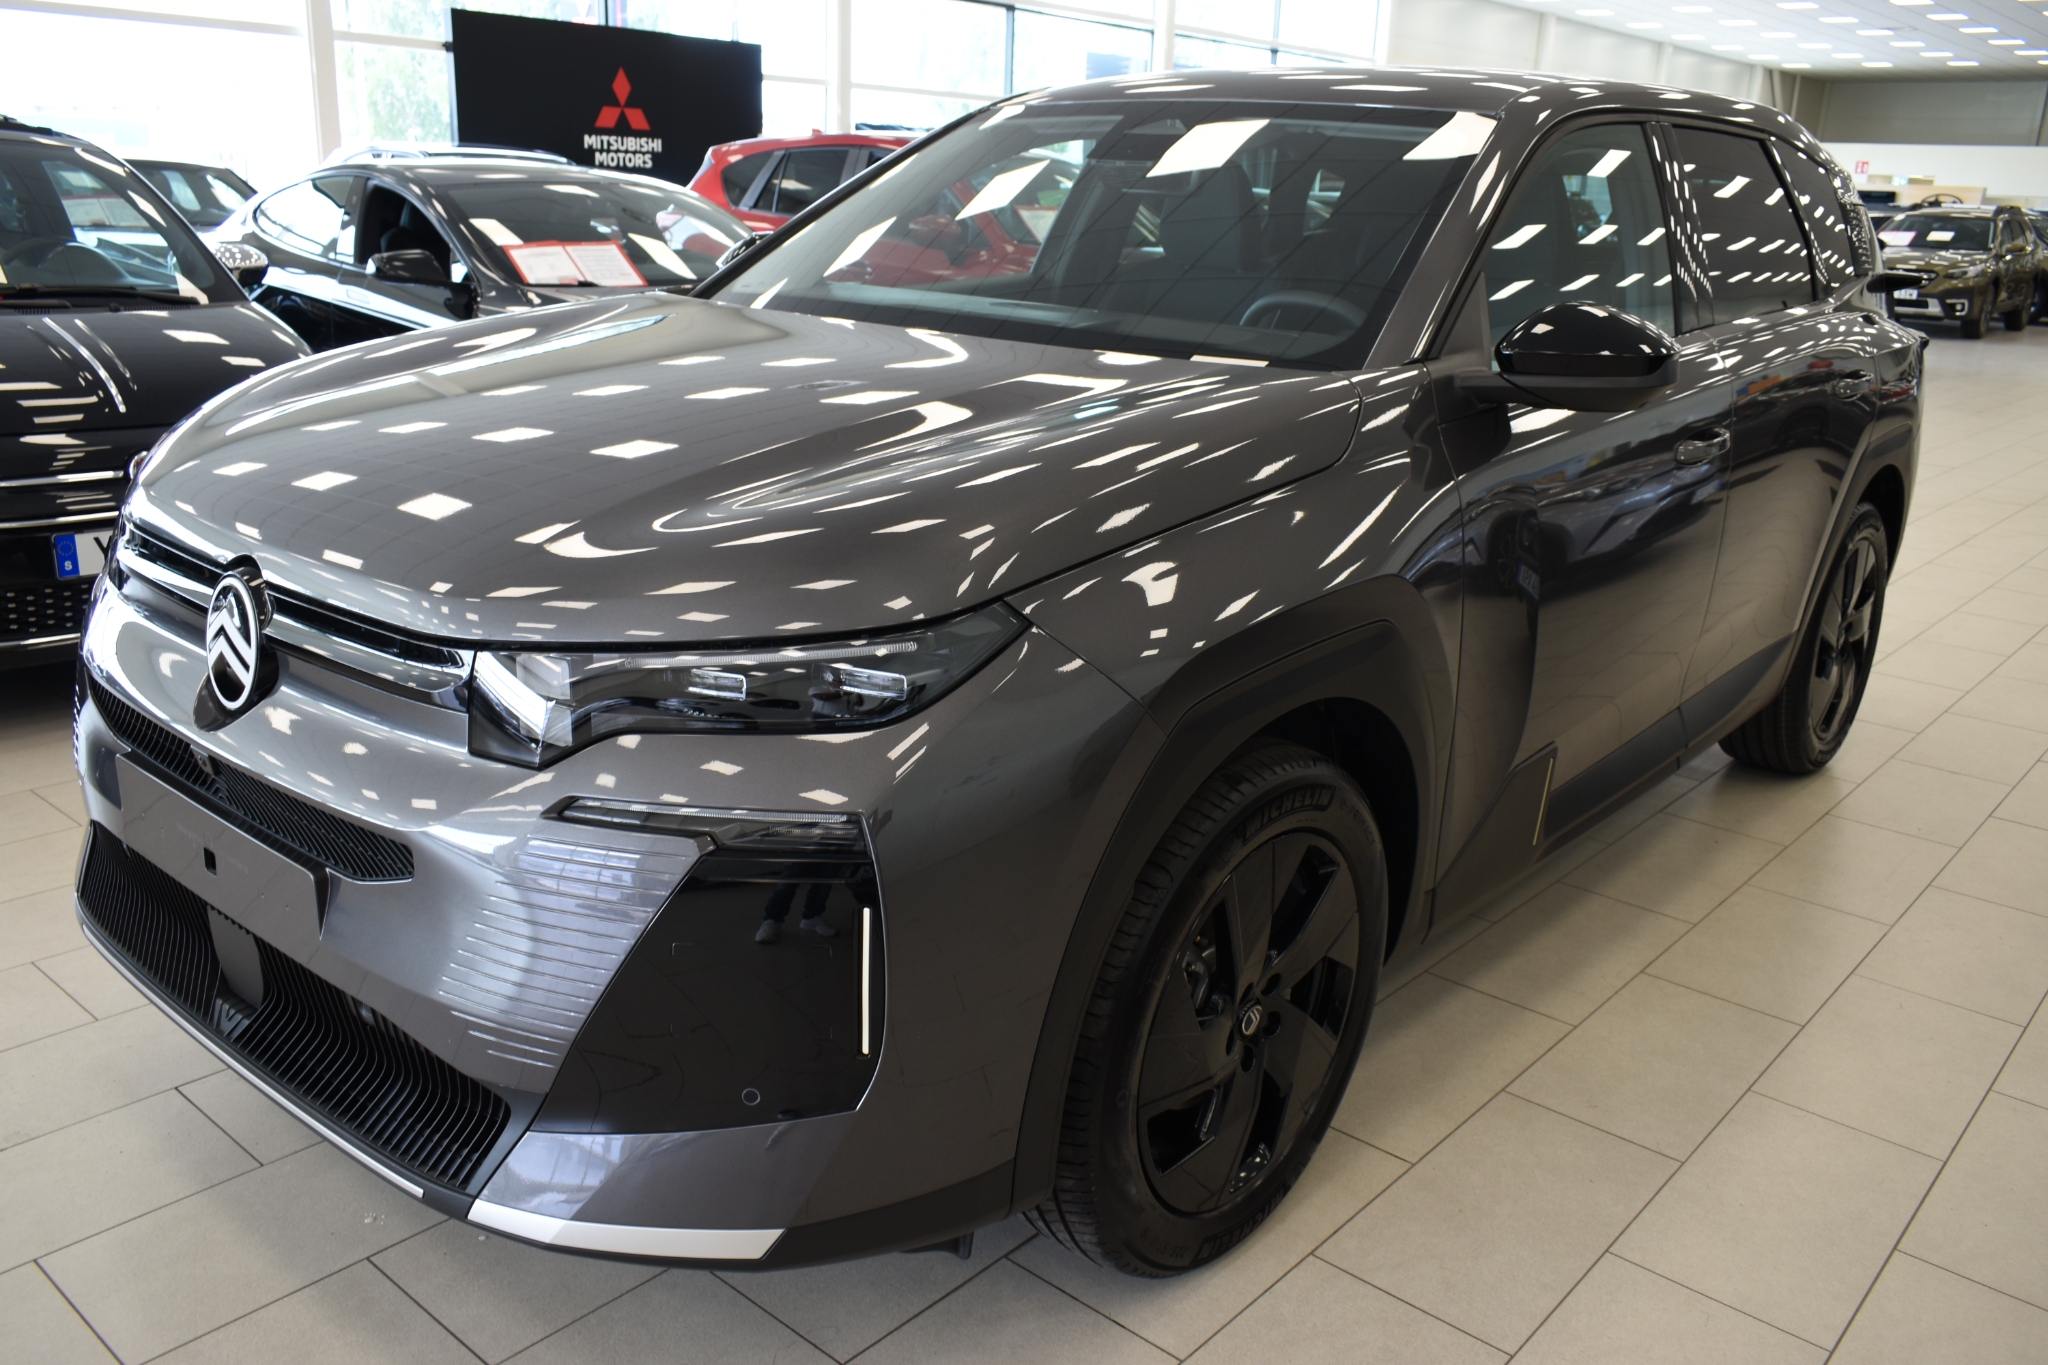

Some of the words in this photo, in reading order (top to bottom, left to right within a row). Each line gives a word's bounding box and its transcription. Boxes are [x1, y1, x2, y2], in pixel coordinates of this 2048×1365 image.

[583, 134, 662, 153] MITSUBISHI
[594, 151, 653, 169] MOTORS
[64, 560, 73, 571] S
[1245, 787, 1333, 840] MICHELIN
[1197, 1187, 1285, 1261] MICHELIN
